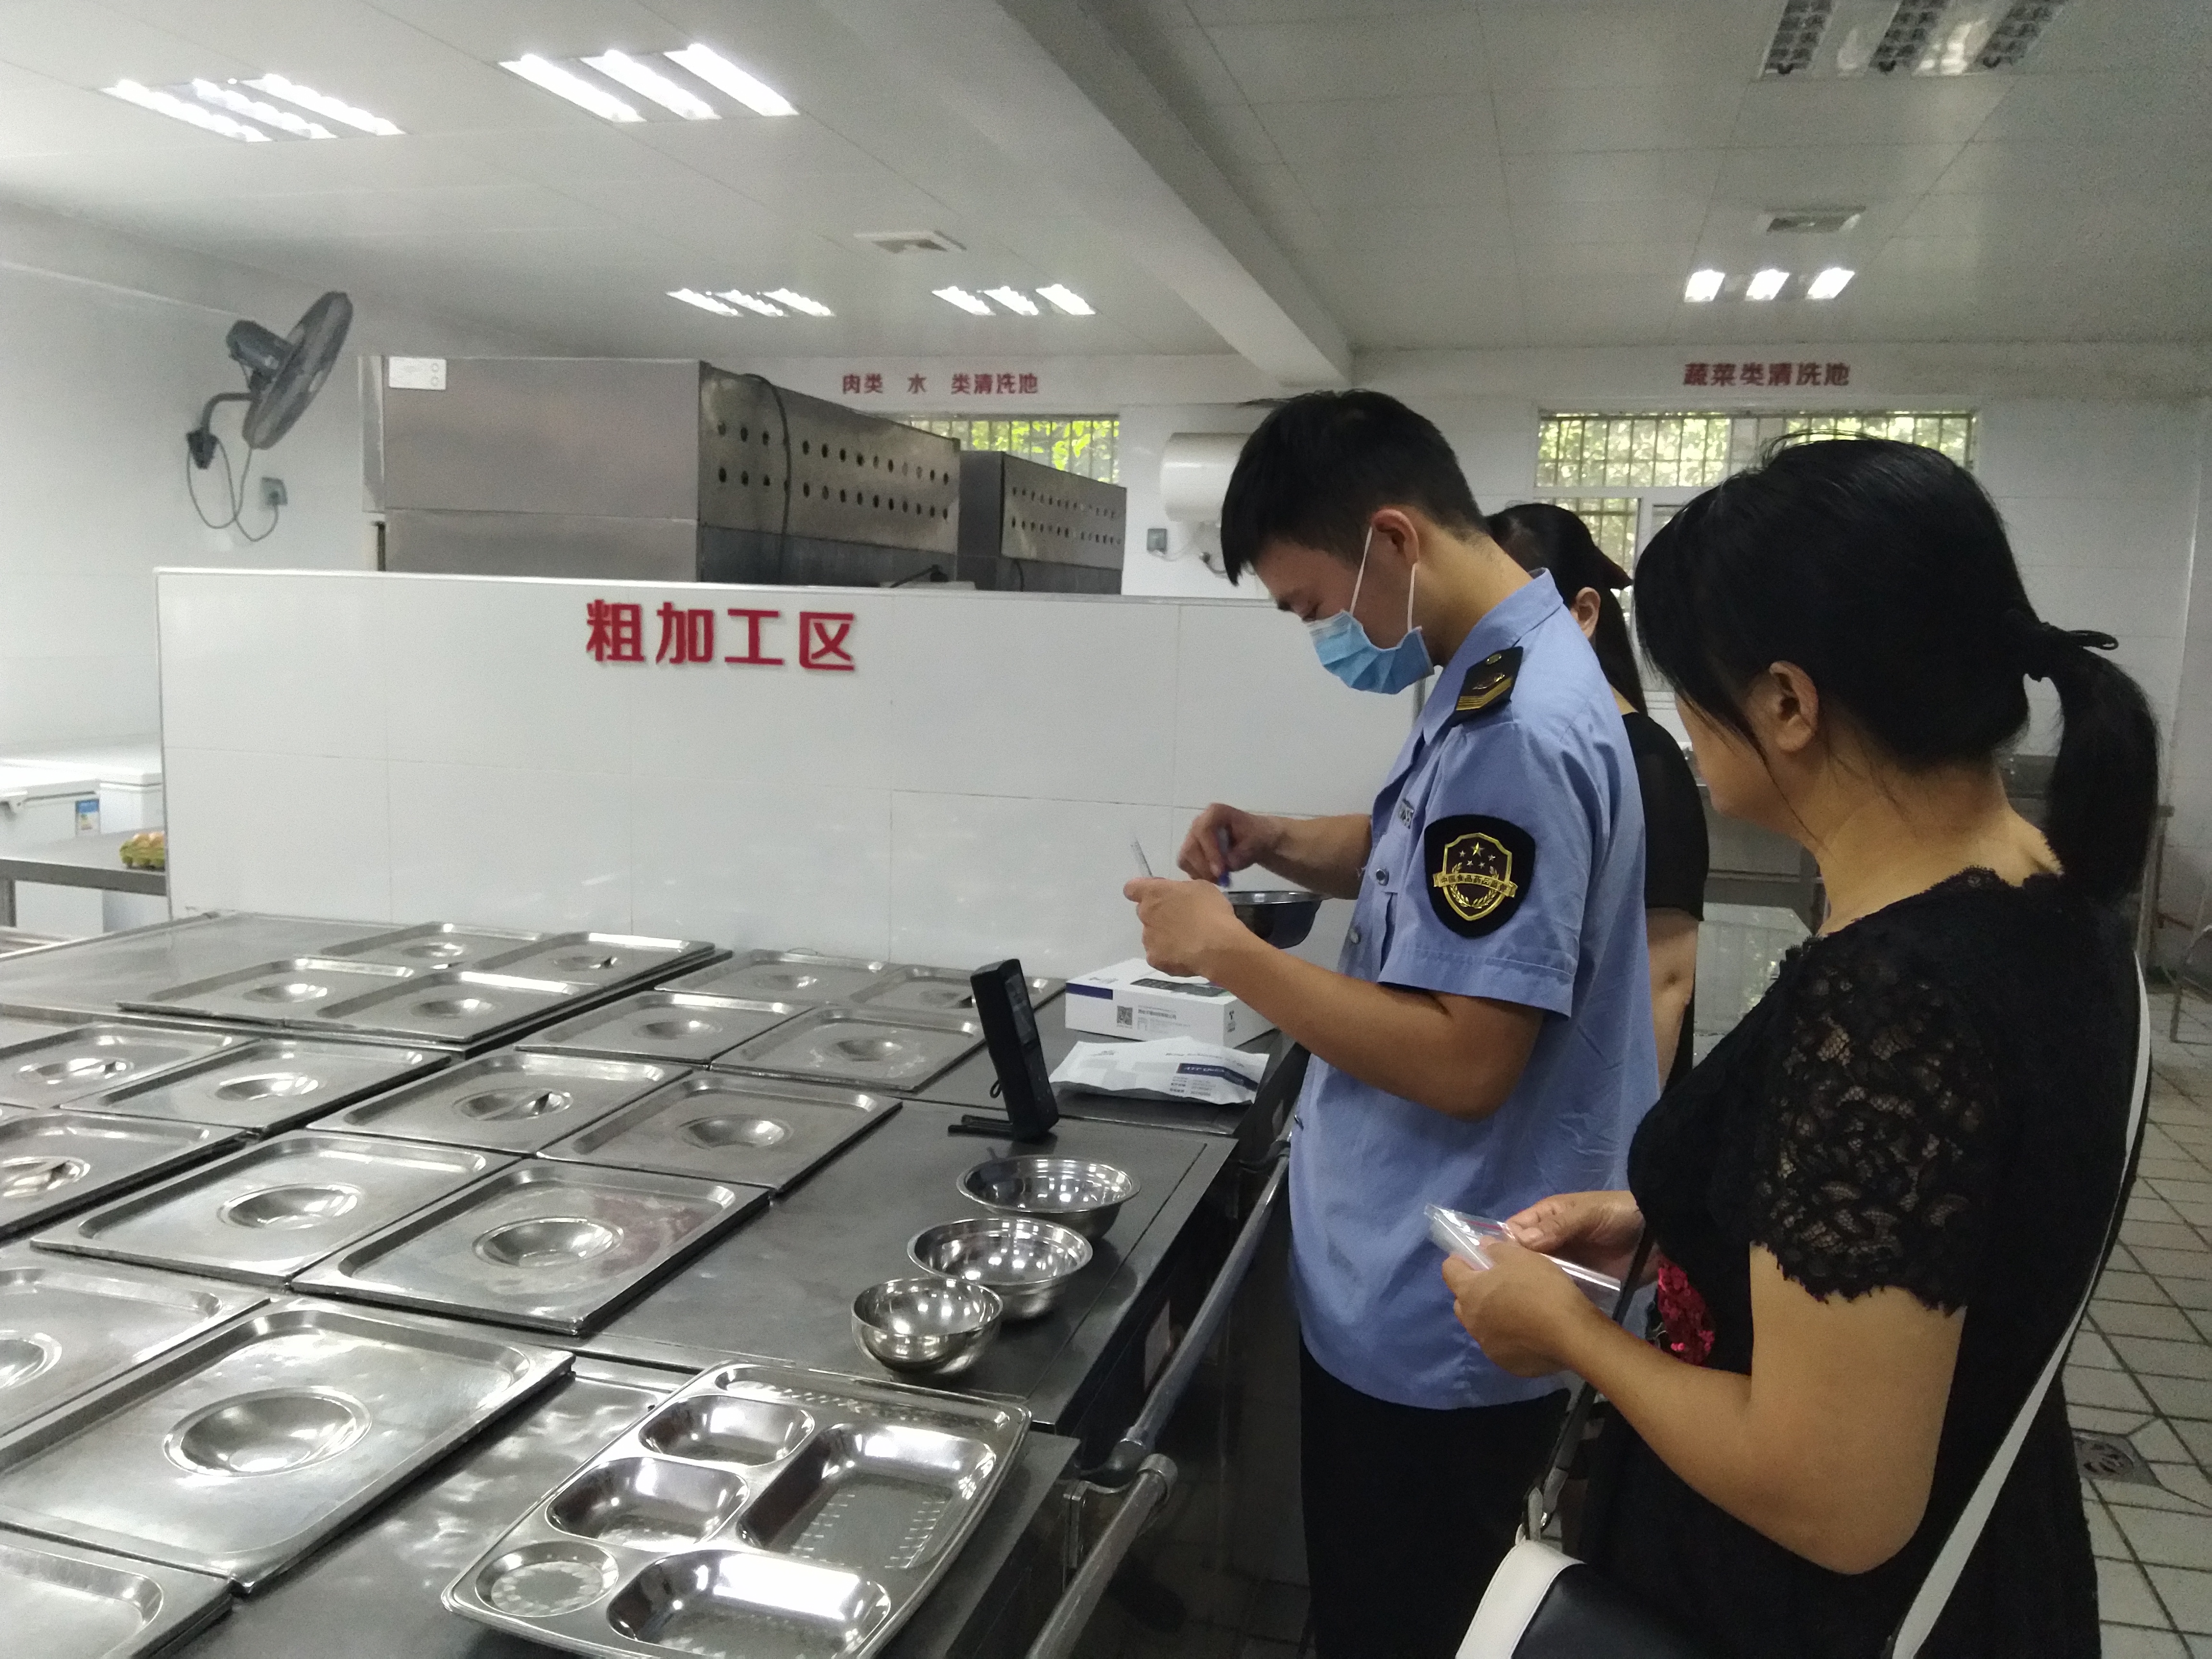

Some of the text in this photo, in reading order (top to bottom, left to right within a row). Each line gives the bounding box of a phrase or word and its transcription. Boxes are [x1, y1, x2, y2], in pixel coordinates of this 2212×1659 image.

[1683, 362, 1851, 386] 蔬菜类清洗池
[586, 599, 855, 671] 粗加工区
